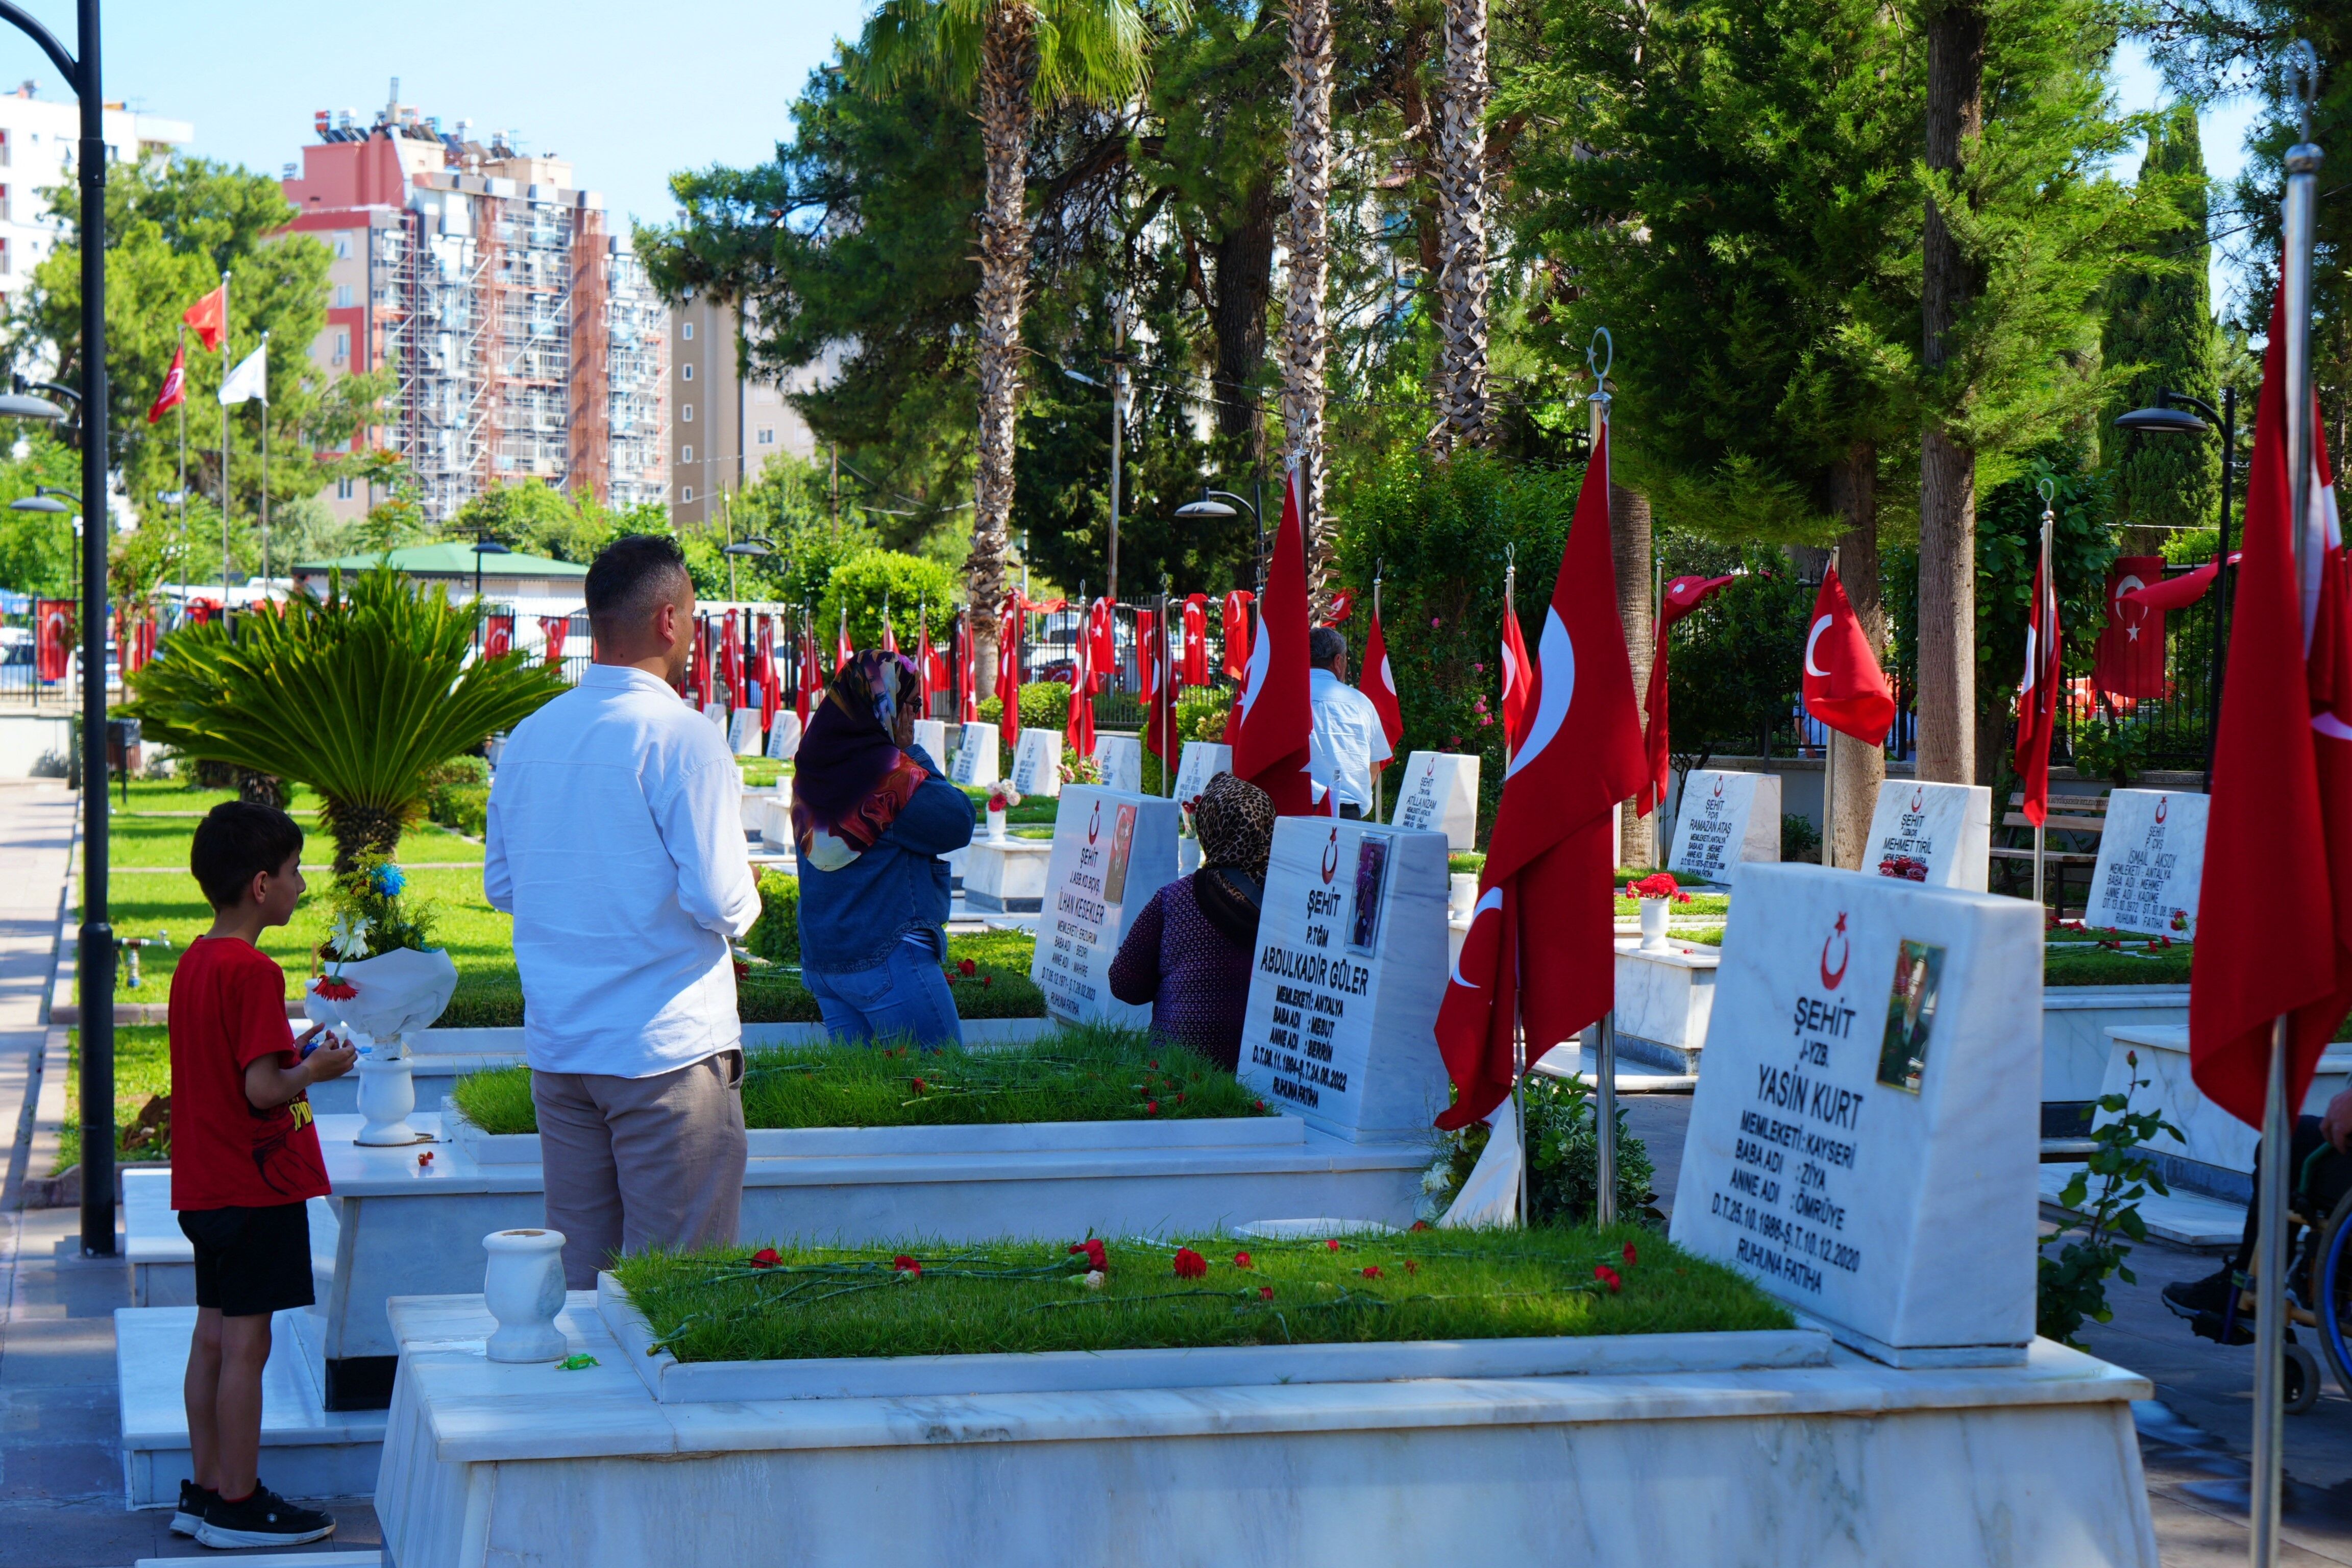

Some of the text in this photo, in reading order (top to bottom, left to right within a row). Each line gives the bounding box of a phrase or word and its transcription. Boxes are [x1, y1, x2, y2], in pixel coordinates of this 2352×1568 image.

[1706, 797, 1725, 813] ŞEHİT
[1689, 819, 1732, 838] RAMAZAN ATAŞ
[1901, 811, 1925, 830] ŞEHİT
[1080, 847, 1098, 869] ŞEHİT
[1883, 837, 1932, 854] MEHMET TİRİL
[2128, 847, 2177, 869] İSMAİL AKSOY
[2108, 874, 2122, 886] BABA
[2125, 876, 2136, 888] ADI
[2140, 879, 2164, 892] MEHMET
[2145, 867, 2171, 880] ANTALYA
[1058, 886, 1104, 926] İLHAN KESEKLER
[1307, 886, 1341, 919] ŞEHİT
[2105, 887, 2120, 898] ANNE
[2122, 889, 2133, 900] ADI
[2115, 912, 2138, 925] RUHUNA
[1054, 935, 1064, 949] BABA
[1079, 928, 1097, 945] ERZURUM
[1051, 951, 1062, 966] ANNE
[1260, 945, 1369, 996] ABDULKADİR GÜLER
[1049, 991, 1080, 1016] RUHUNA FATİHA
[1314, 993, 1343, 1018] ANTALYA
[1273, 1005, 1289, 1026] BABA
[1289, 1010, 1301, 1030] ADI
[1794, 996, 1856, 1039] ŞEHİT
[1269, 1026, 1288, 1048] ANNE
[1287, 1031, 1299, 1051] ADI
[1272, 1076, 1318, 1109] RUHUNA FATİHA
[1757, 1063, 1864, 1131] YASİN KURT
[1735, 1138, 1762, 1169] BABA
[1763, 1149, 1784, 1175] ADI
[1806, 1132, 1857, 1170] KAYSERİ
[1729, 1167, 1760, 1197] ANNE
[1759, 1179, 1780, 1205] ADI
[1736, 1237, 1822, 1295] RUHUNA FATİHA
